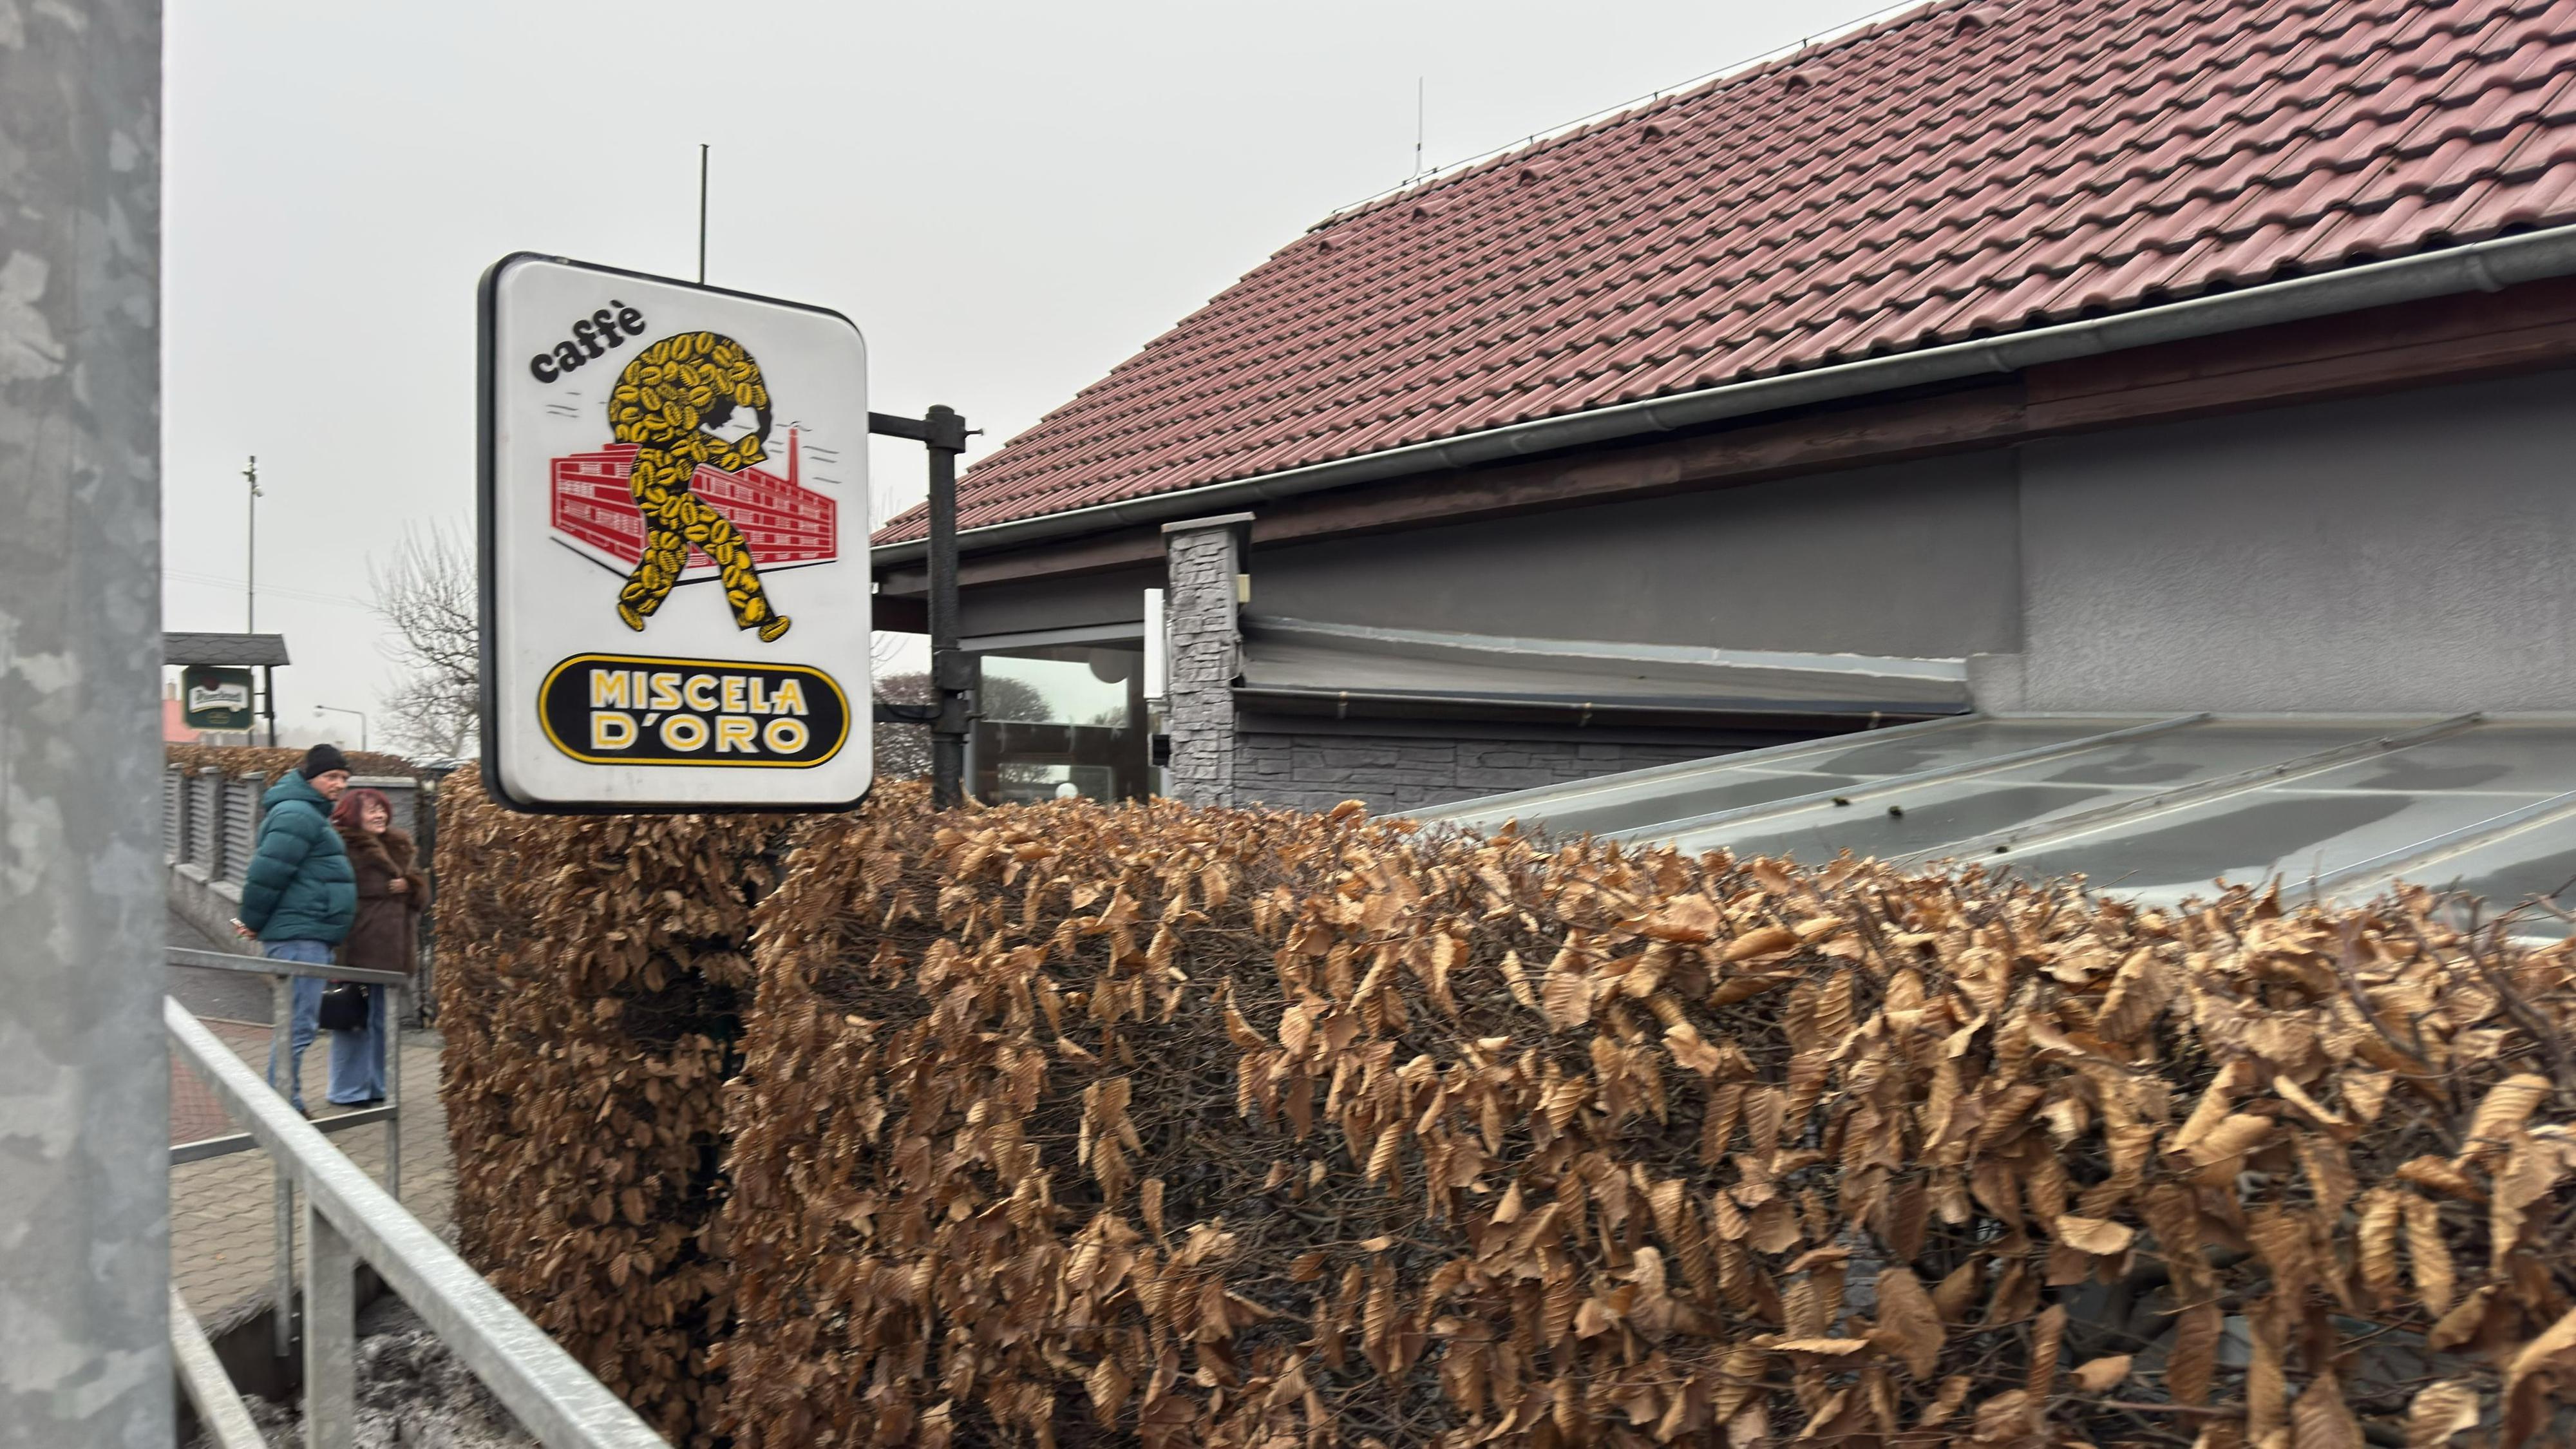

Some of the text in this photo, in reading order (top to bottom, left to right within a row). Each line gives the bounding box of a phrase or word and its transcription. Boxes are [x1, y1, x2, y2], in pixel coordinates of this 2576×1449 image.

[530, 299, 646, 384] caffè
[589, 668, 810, 715] MISCELA
[590, 710, 810, 754] D'ORO
